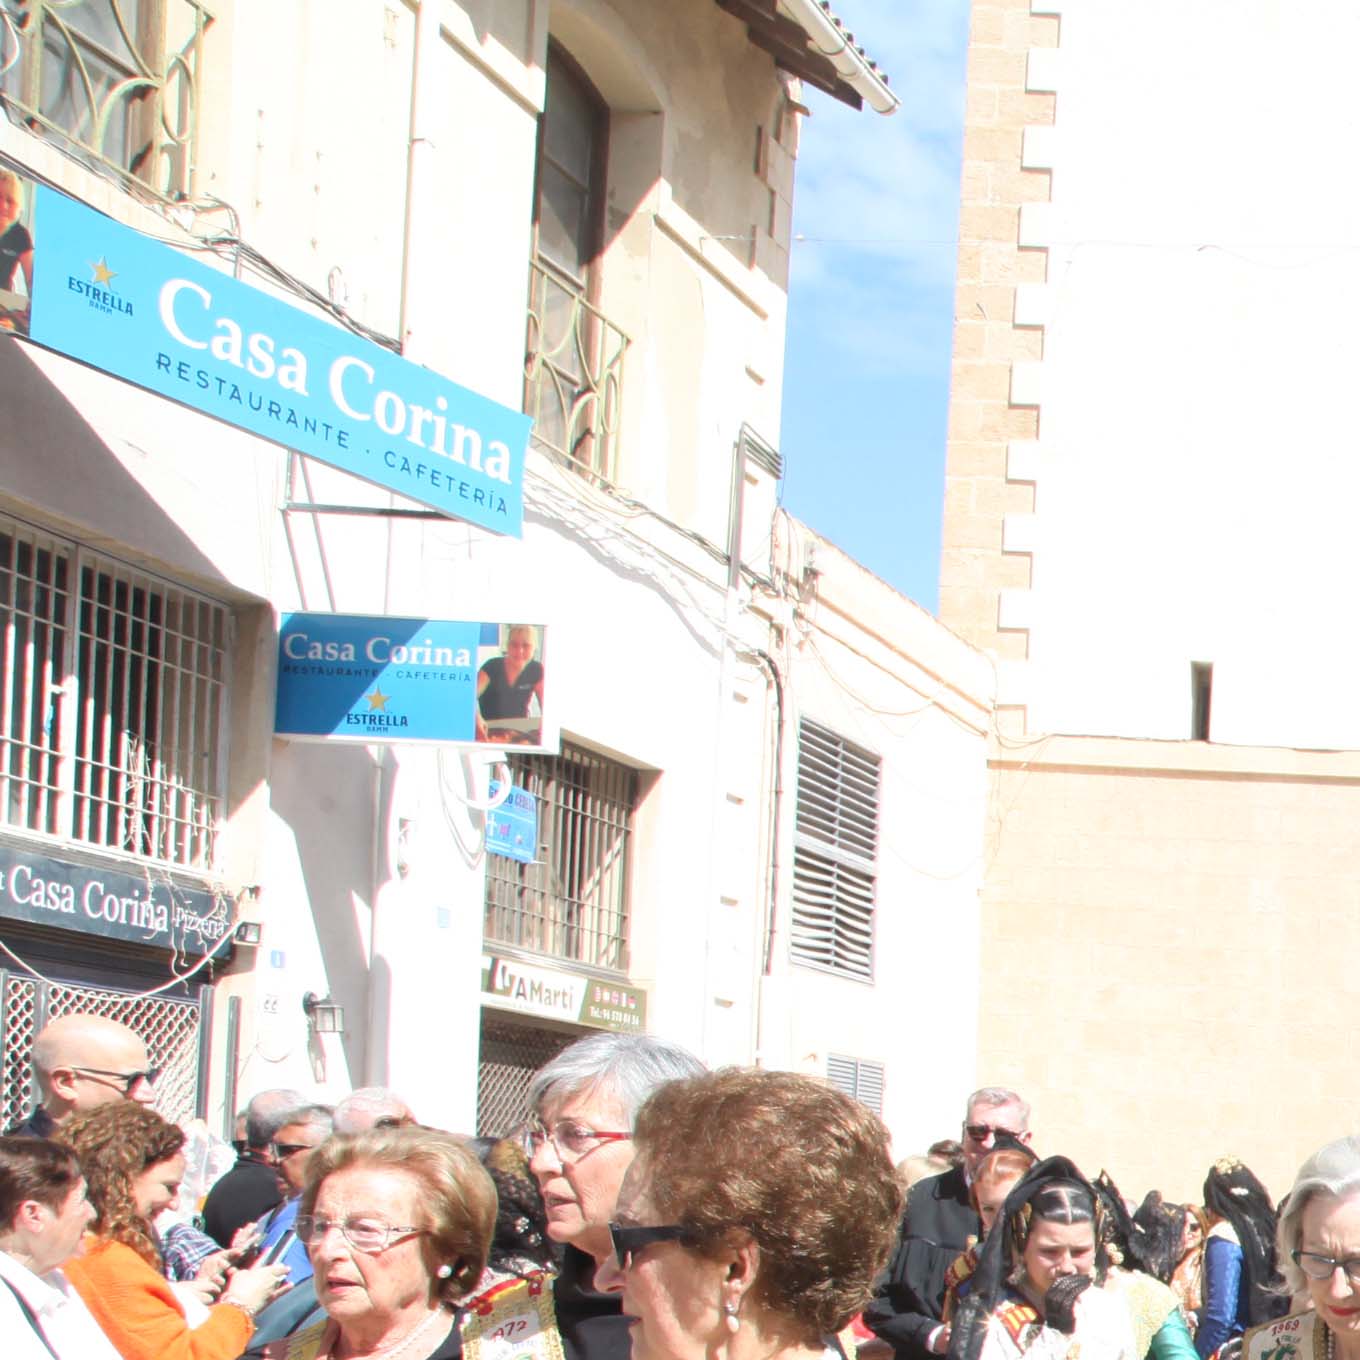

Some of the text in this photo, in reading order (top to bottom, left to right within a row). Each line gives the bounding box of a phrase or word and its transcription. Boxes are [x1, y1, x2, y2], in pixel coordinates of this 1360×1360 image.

[68, 276, 133, 316] ESTRELLA
[158, 277, 512, 485] Casa Corina
[155, 352, 509, 517] RESTAURANTE CAFETERÍA
[284, 633, 472, 668] Casa Corina
[283, 664, 379, 679] RESTAURANTE
[346, 713, 409, 727] ESTRELLA
[9, 865, 75, 914] Casa
[83, 880, 169, 933] Corina
[1271, 1319, 1300, 1336] 1969
